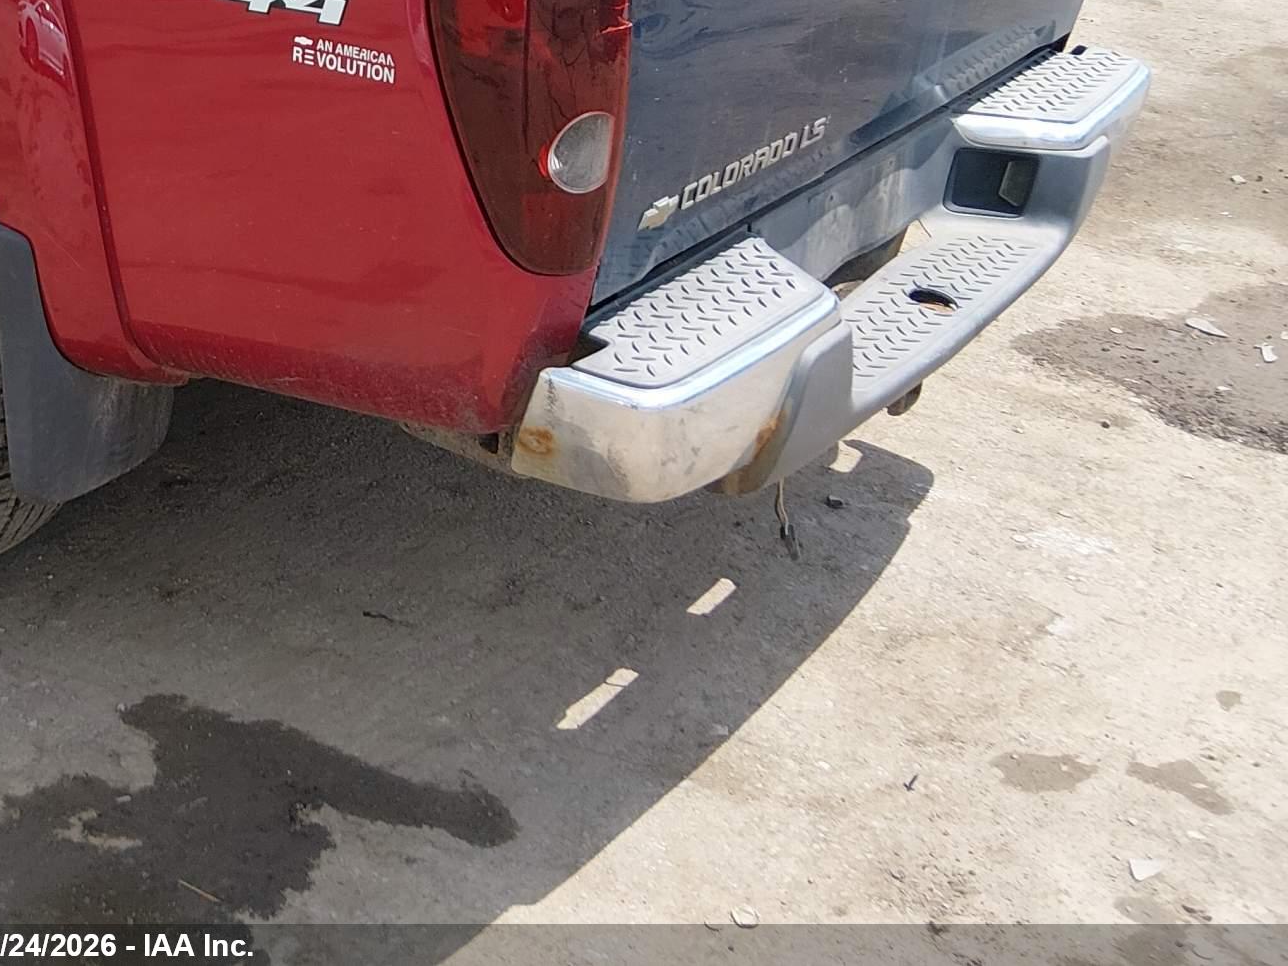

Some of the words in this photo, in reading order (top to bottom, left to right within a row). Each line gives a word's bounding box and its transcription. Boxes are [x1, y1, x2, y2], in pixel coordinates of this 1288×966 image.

[292, 46, 395, 84] REVOLUTION
[316, 39, 333, 53] AN
[335, 43, 395, 67] AMERICAN
[680, 131, 799, 210] COLORADO
[799, 116, 827, 149] LS
